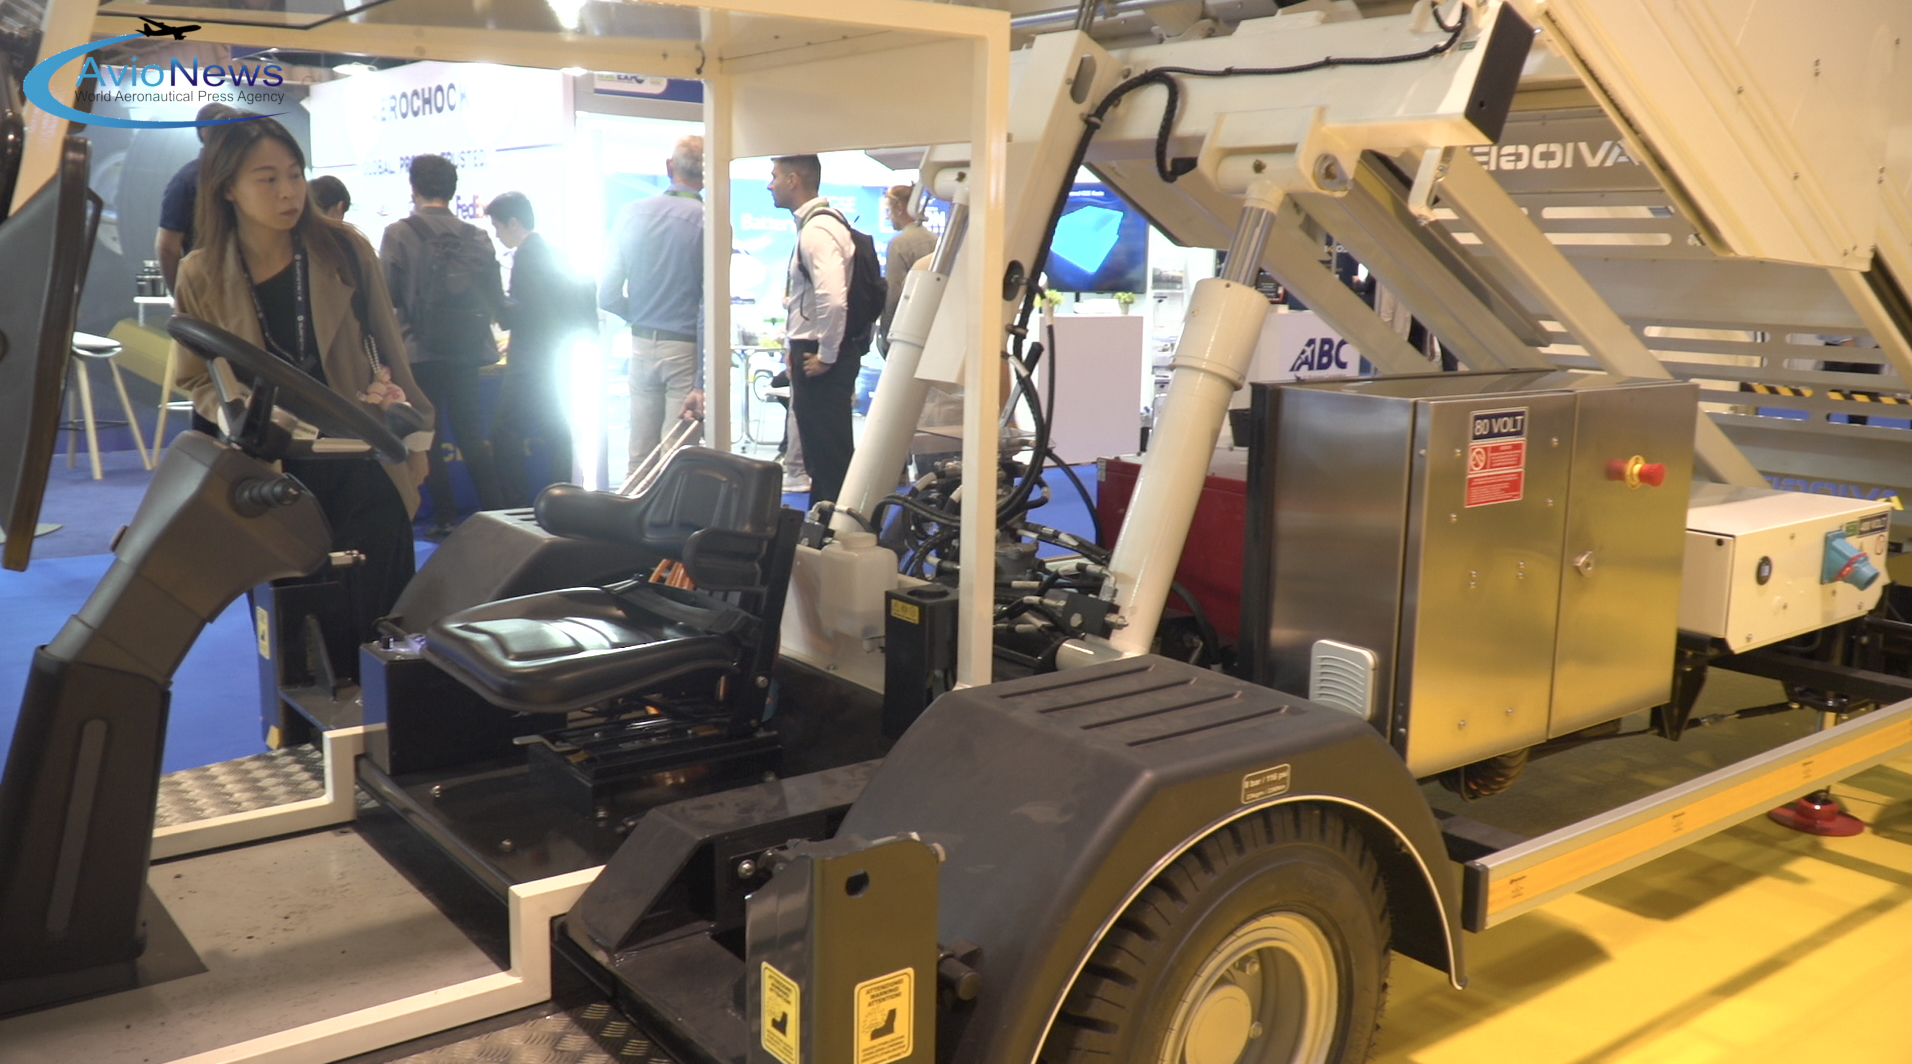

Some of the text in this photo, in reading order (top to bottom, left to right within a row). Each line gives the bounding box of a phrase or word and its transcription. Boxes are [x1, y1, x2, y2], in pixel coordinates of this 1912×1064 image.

[1289, 337, 1350, 372] ABC
[1474, 415, 1525, 436] 80 VOLT
